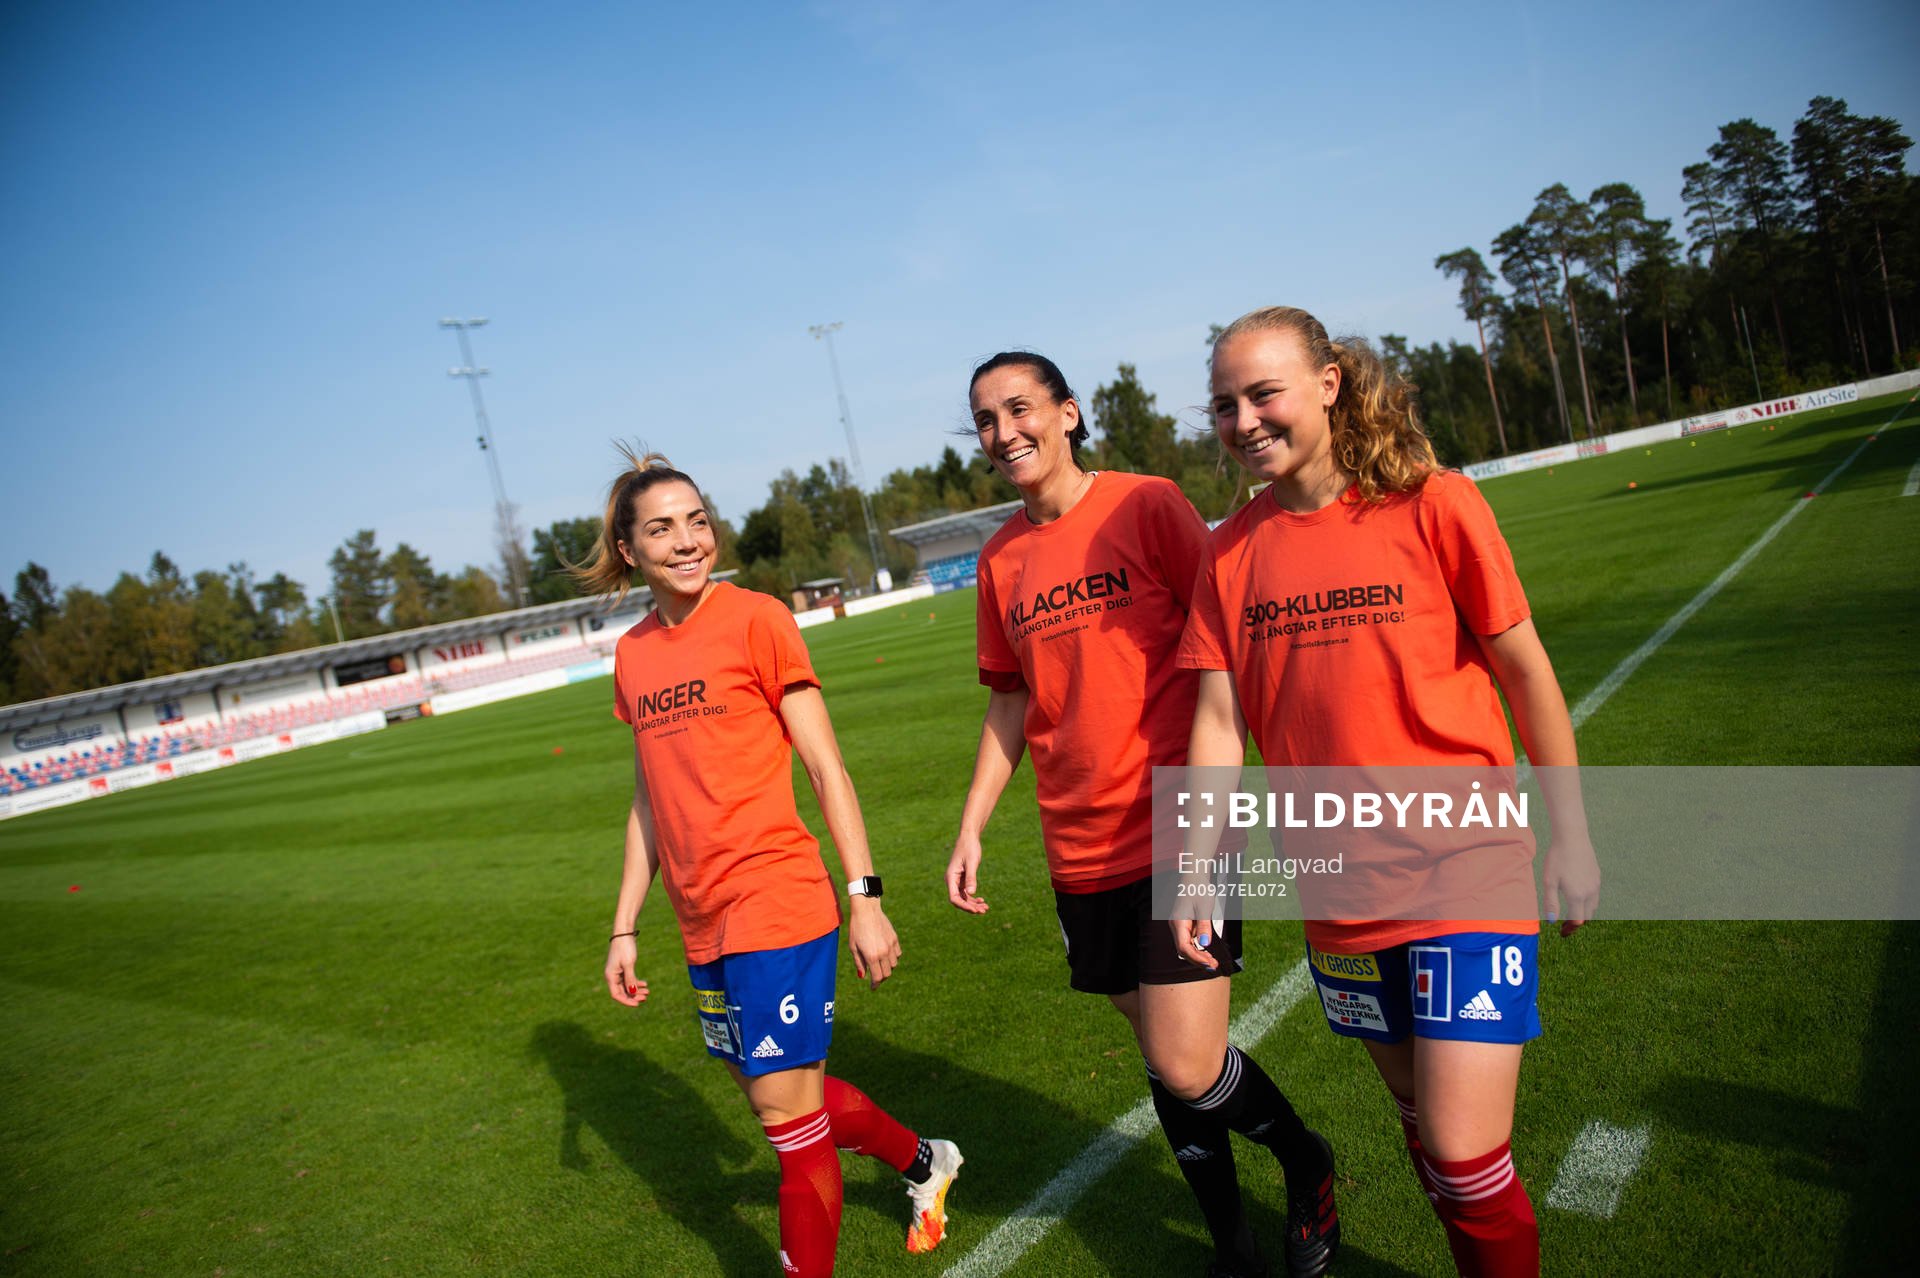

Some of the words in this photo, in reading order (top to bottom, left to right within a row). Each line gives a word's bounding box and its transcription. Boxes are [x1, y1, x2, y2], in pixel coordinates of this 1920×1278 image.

[1751, 398, 1802, 419] NIBE
[1805, 388, 1857, 409] AirSite
[1011, 567, 1131, 632] KLACKEN
[1066, 603, 1102, 622] EFTER
[1106, 596, 1134, 611] DIG!
[1244, 584, 1404, 627] 300-KLUBBEN
[1321, 613, 1367, 629] EFTER
[1373, 611, 1406, 624] DIG!
[637, 679, 707, 720] INGER
[672, 708, 699, 723] EFTER
[703, 705, 728, 716] DIG!
[1326, 955, 1375, 977] GROSS
[1491, 945, 1524, 987] 18
[779, 993, 800, 1025] 6
[1458, 1009, 1503, 1022] adidas
[752, 1047, 784, 1059] adidas
